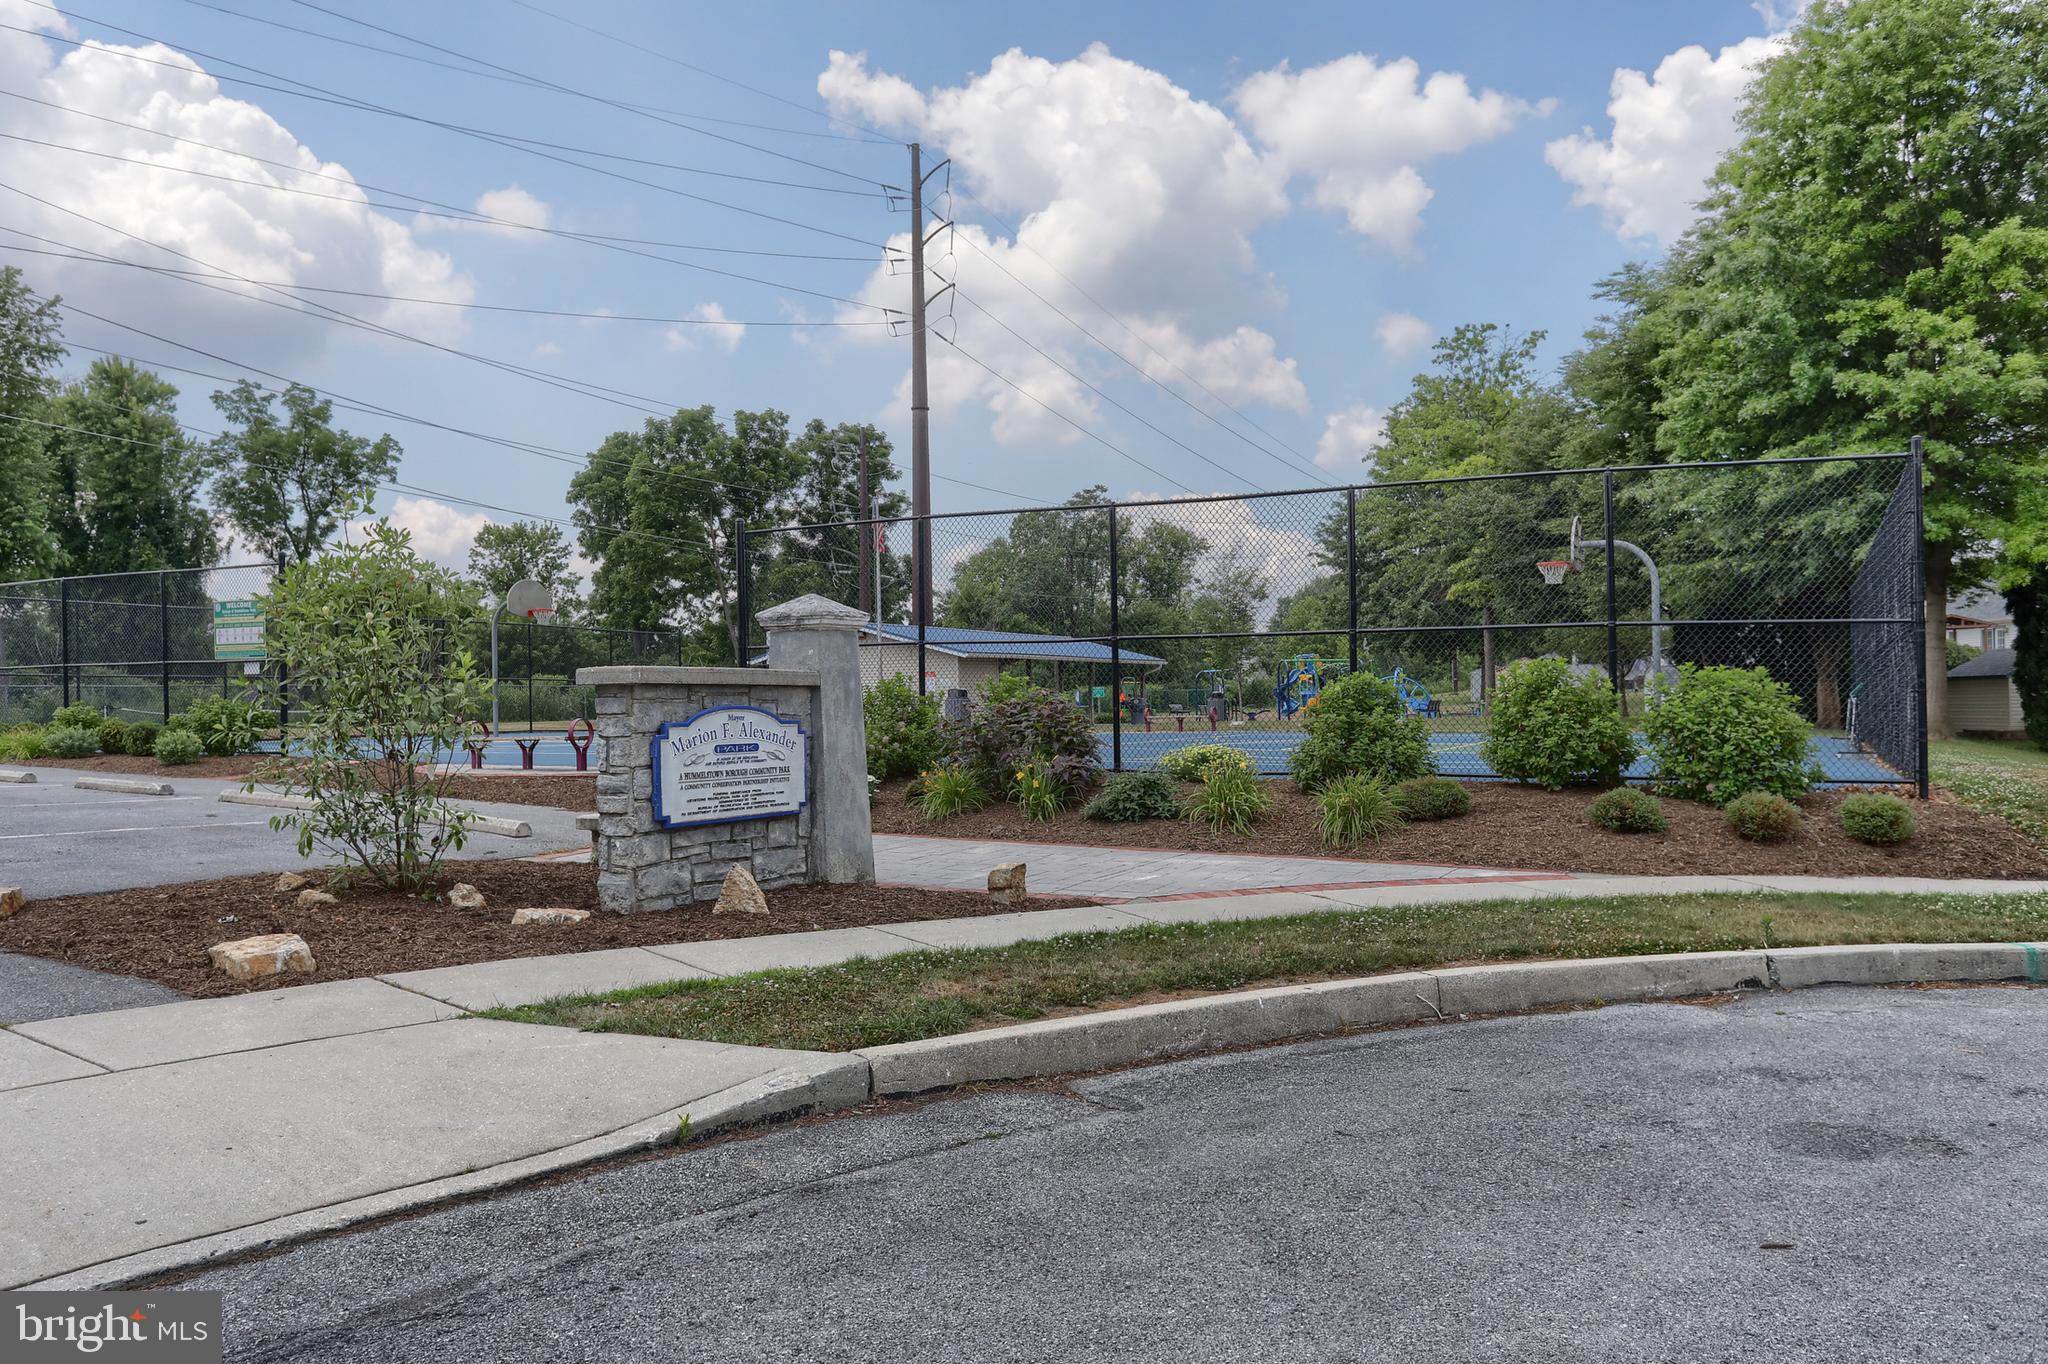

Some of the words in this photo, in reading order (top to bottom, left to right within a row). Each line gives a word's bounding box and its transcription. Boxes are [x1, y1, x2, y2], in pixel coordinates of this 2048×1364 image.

[728, 714, 744, 722] Mayor
[670, 728, 717, 756] Marion
[722, 722, 734, 738] F.
[739, 721, 797, 750] Alexander
[716, 744, 756, 752] PARK
[684, 770, 724, 780] HUMMELSTOWN
[725, 768, 748, 777] BOROUGH
[749, 766, 778, 776] COMMUNITY
